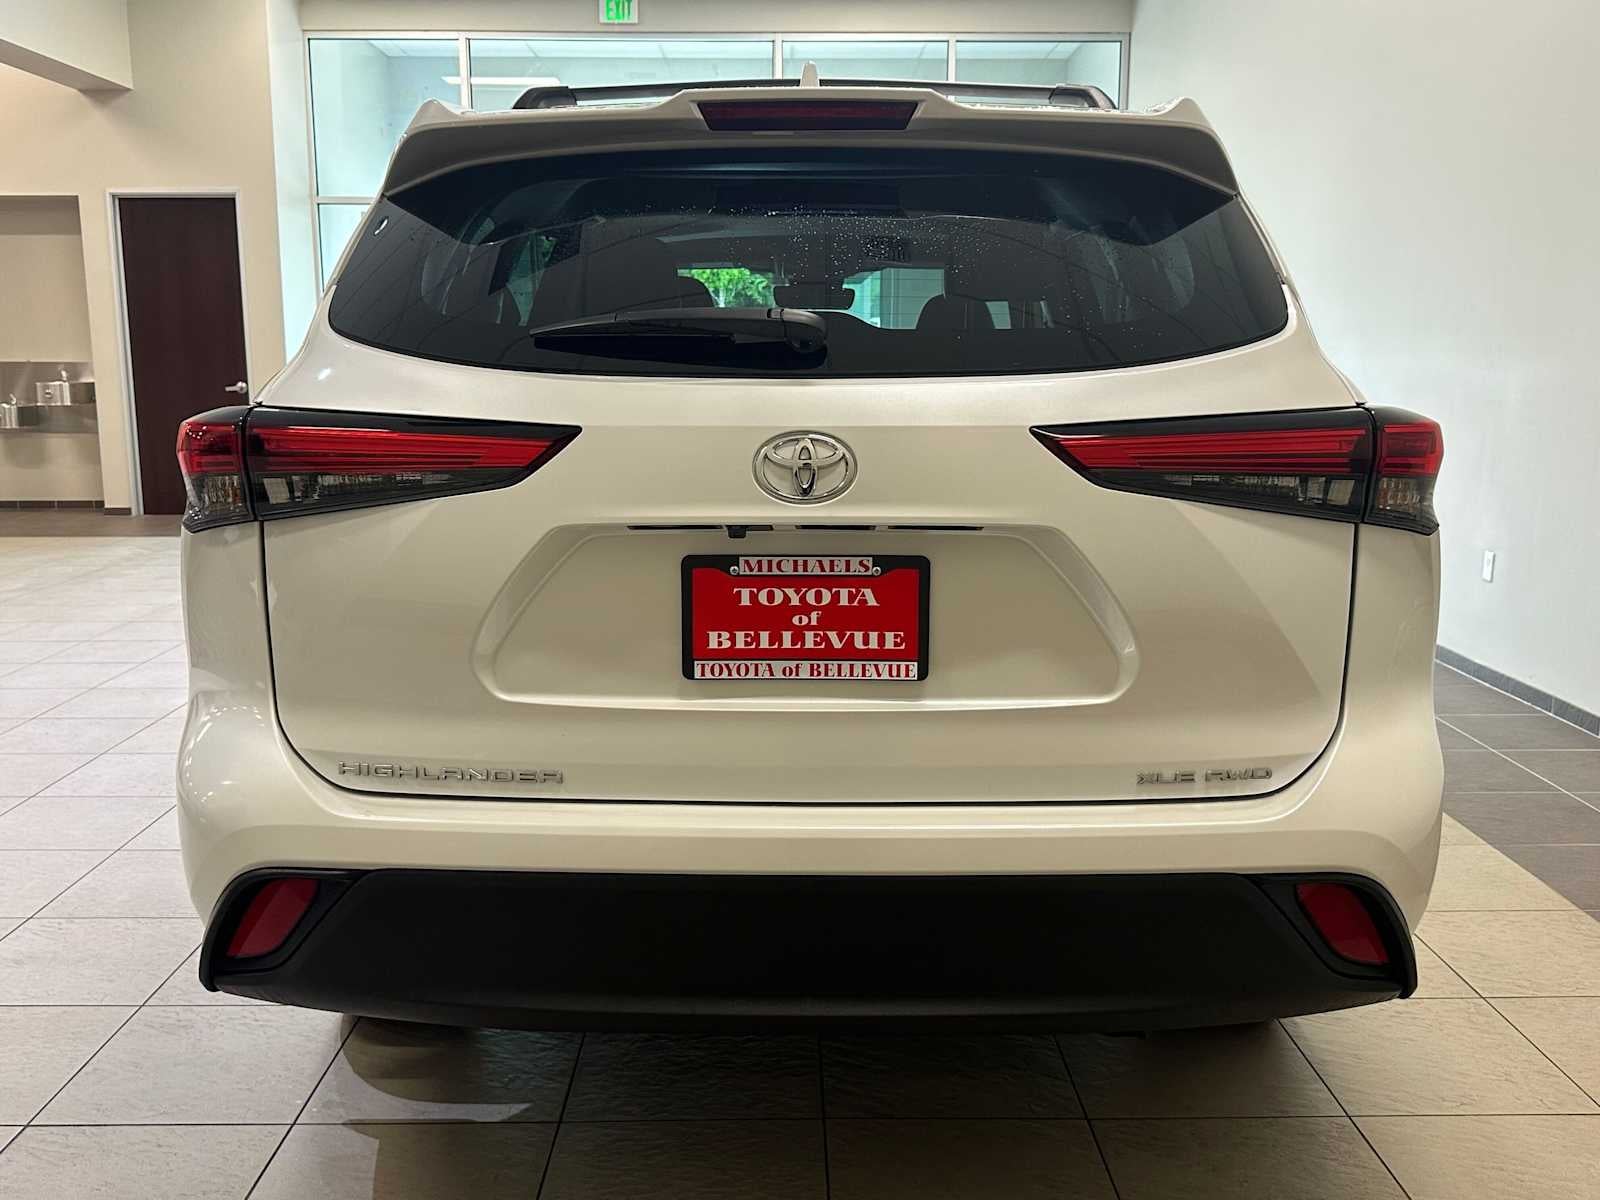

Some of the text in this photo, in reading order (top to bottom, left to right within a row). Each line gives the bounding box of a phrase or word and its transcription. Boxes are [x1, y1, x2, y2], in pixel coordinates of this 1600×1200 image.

[605, 0, 632, 20] EXIT
[742, 558, 871, 574] MICHAELS
[732, 587, 880, 606] TOYOTA
[791, 611, 822, 626] of
[706, 631, 906, 650] BELLEVUE
[696, 662, 917, 679] TOYOTA of BELLEVUE
[338, 761, 564, 785] HIGHLANDER
